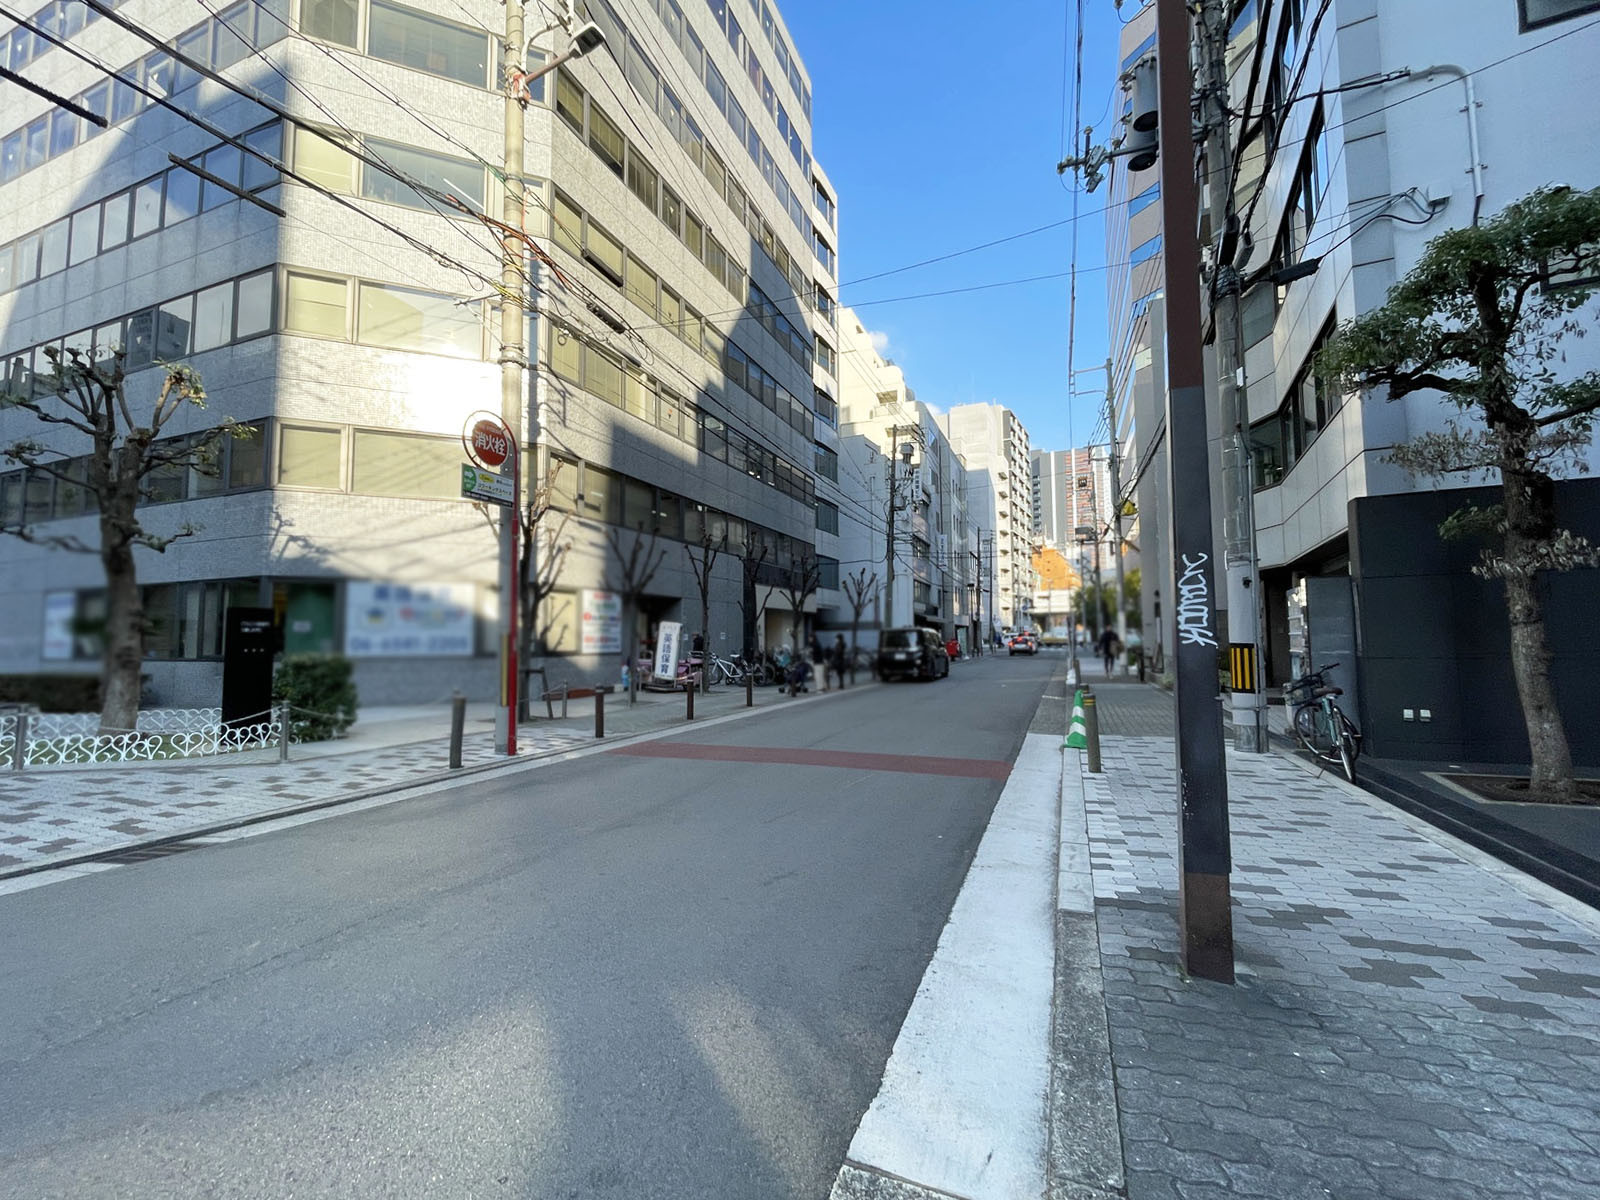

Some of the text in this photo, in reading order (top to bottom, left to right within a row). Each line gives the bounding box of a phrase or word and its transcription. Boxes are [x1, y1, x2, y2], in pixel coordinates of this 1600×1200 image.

[475, 432, 505, 455] 消火栓
[661, 633, 673, 674] 英語保育
